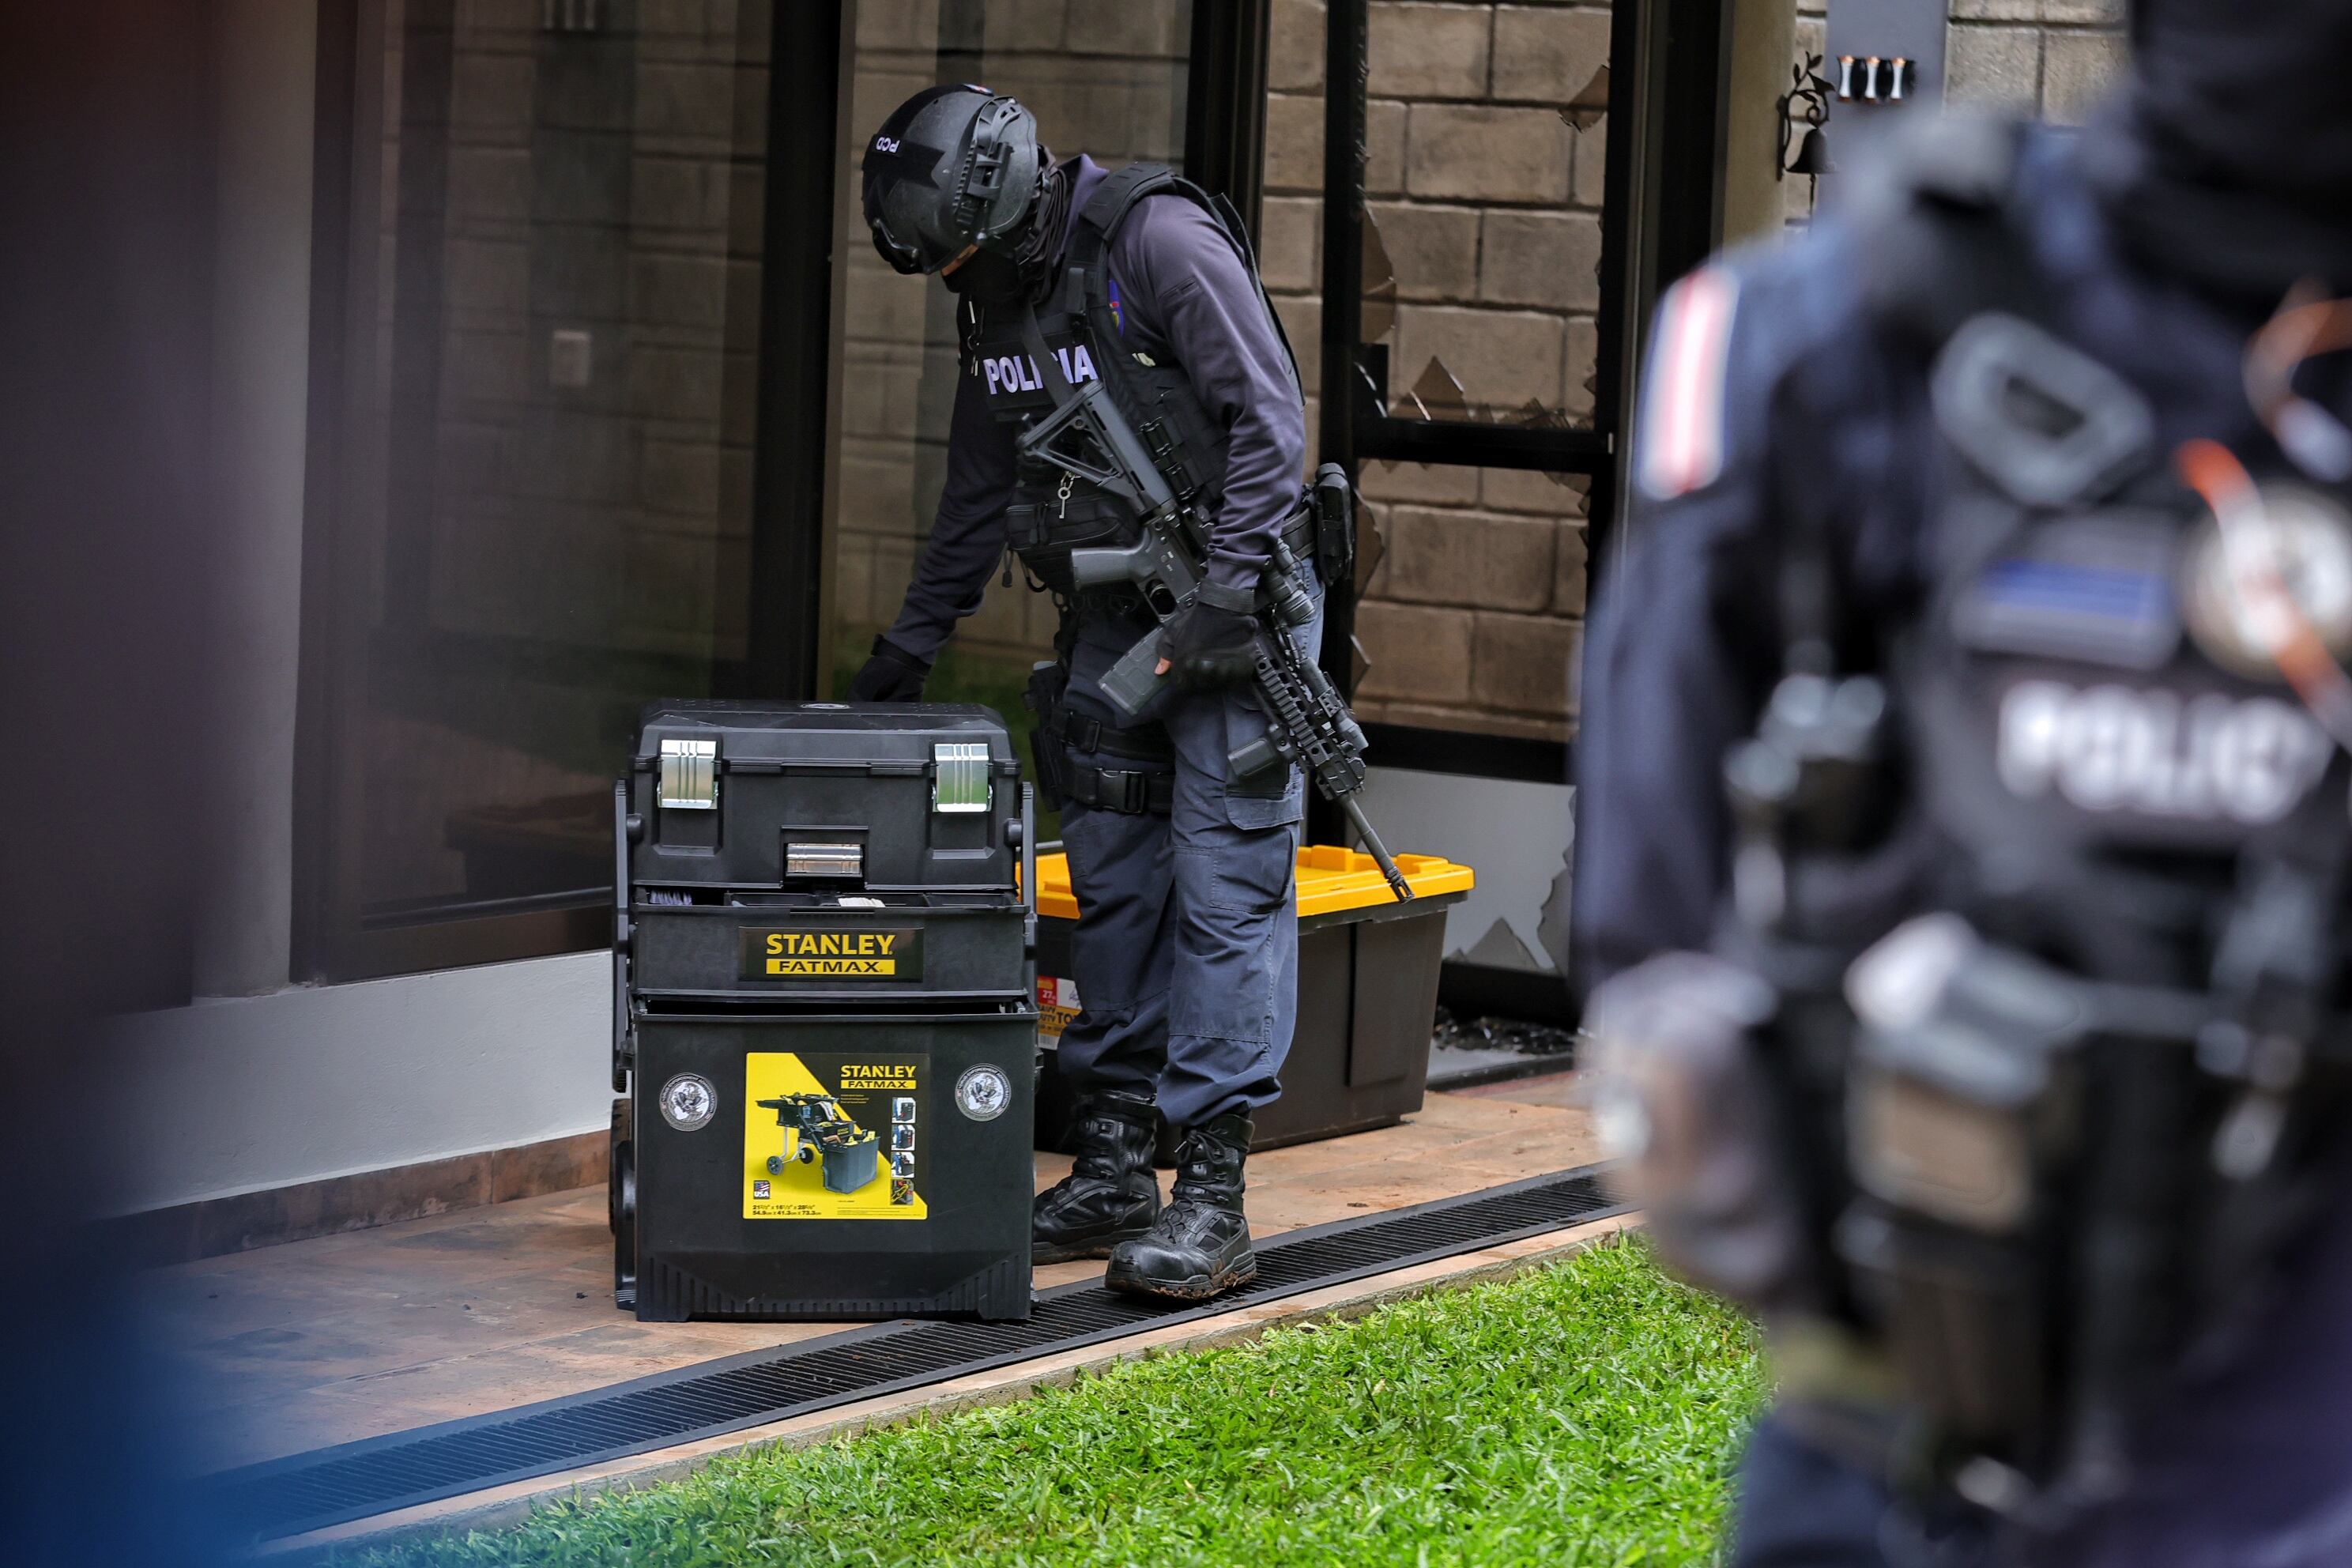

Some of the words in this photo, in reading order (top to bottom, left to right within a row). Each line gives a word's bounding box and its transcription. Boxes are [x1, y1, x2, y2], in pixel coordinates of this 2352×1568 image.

[982, 344, 1099, 395] POLIIA
[766, 933, 896, 956] STANLEY
[778, 961, 880, 973] FATMAX
[840, 1065, 917, 1078] STANLEY
